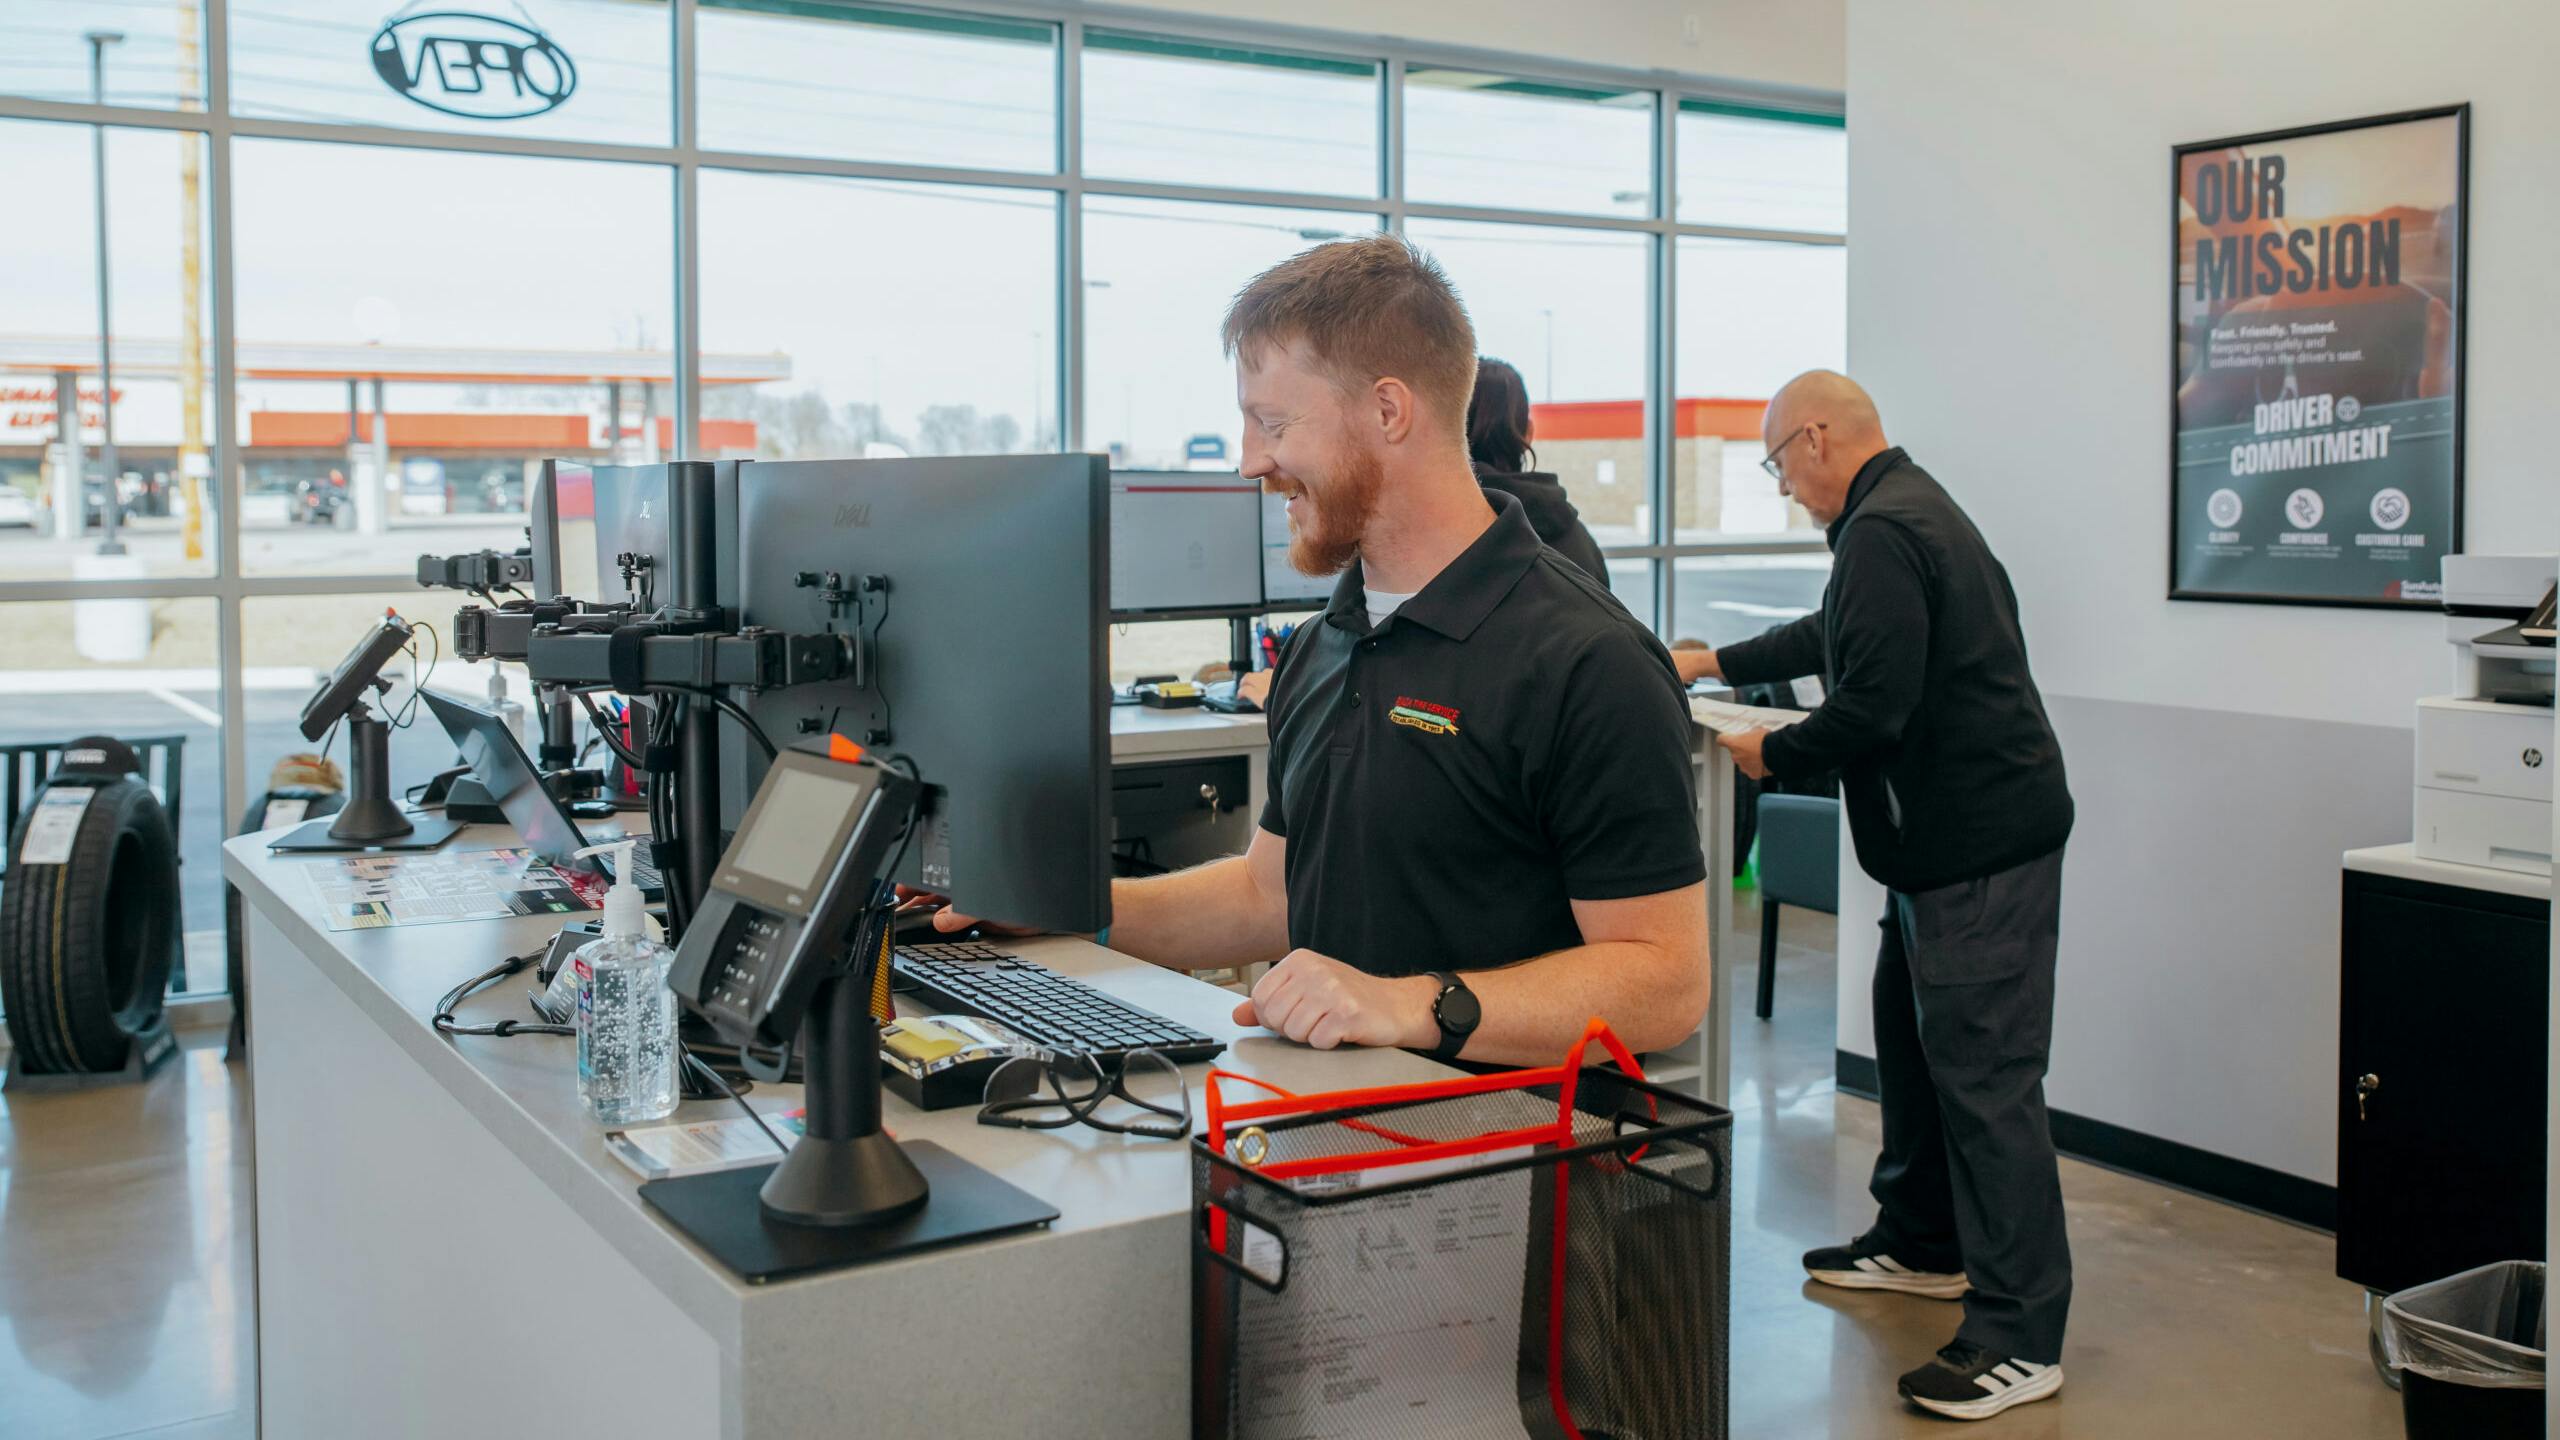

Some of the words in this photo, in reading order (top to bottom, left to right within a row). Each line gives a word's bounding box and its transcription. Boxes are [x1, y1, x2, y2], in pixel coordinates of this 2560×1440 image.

[2196, 155, 2286, 226] OUR
[2195, 218, 2401, 301] MISSION
[2210, 327, 2238, 340] Fast.
[2239, 323, 2288, 338] Friendly.
[2290, 320, 2339, 336] Trusted.
[2254, 393, 2334, 435] DRIVER
[2230, 424, 2392, 477] COMMITMENT
[2523, 747, 2543, 768] hp
